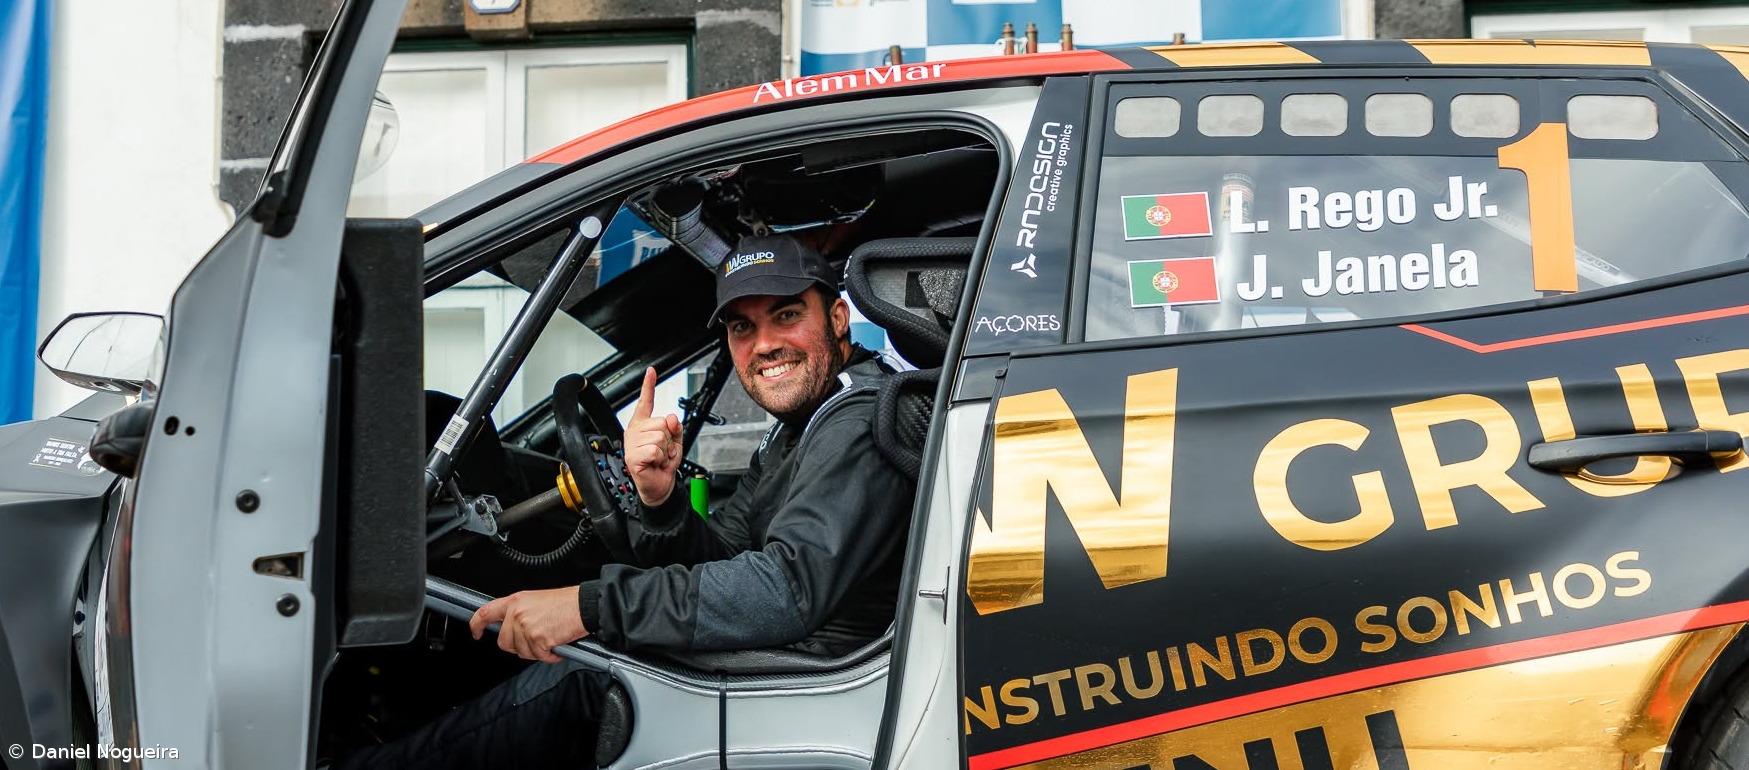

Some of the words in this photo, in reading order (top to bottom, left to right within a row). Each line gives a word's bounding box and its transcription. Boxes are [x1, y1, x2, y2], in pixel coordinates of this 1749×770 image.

[1046, 168, 1063, 212] creative
[1056, 123, 1073, 167] graphics
[1230, 190, 1269, 233] L.
[1288, 184, 1416, 233] Rego
[1433, 175, 1498, 222] Jr.
[1497, 122, 1579, 293] 1
[1236, 254, 1283, 301] J.
[1302, 243, 1480, 297] Janela
[975, 315, 1061, 336] AÇORES
[1354, 551, 1652, 654] SONHOS
